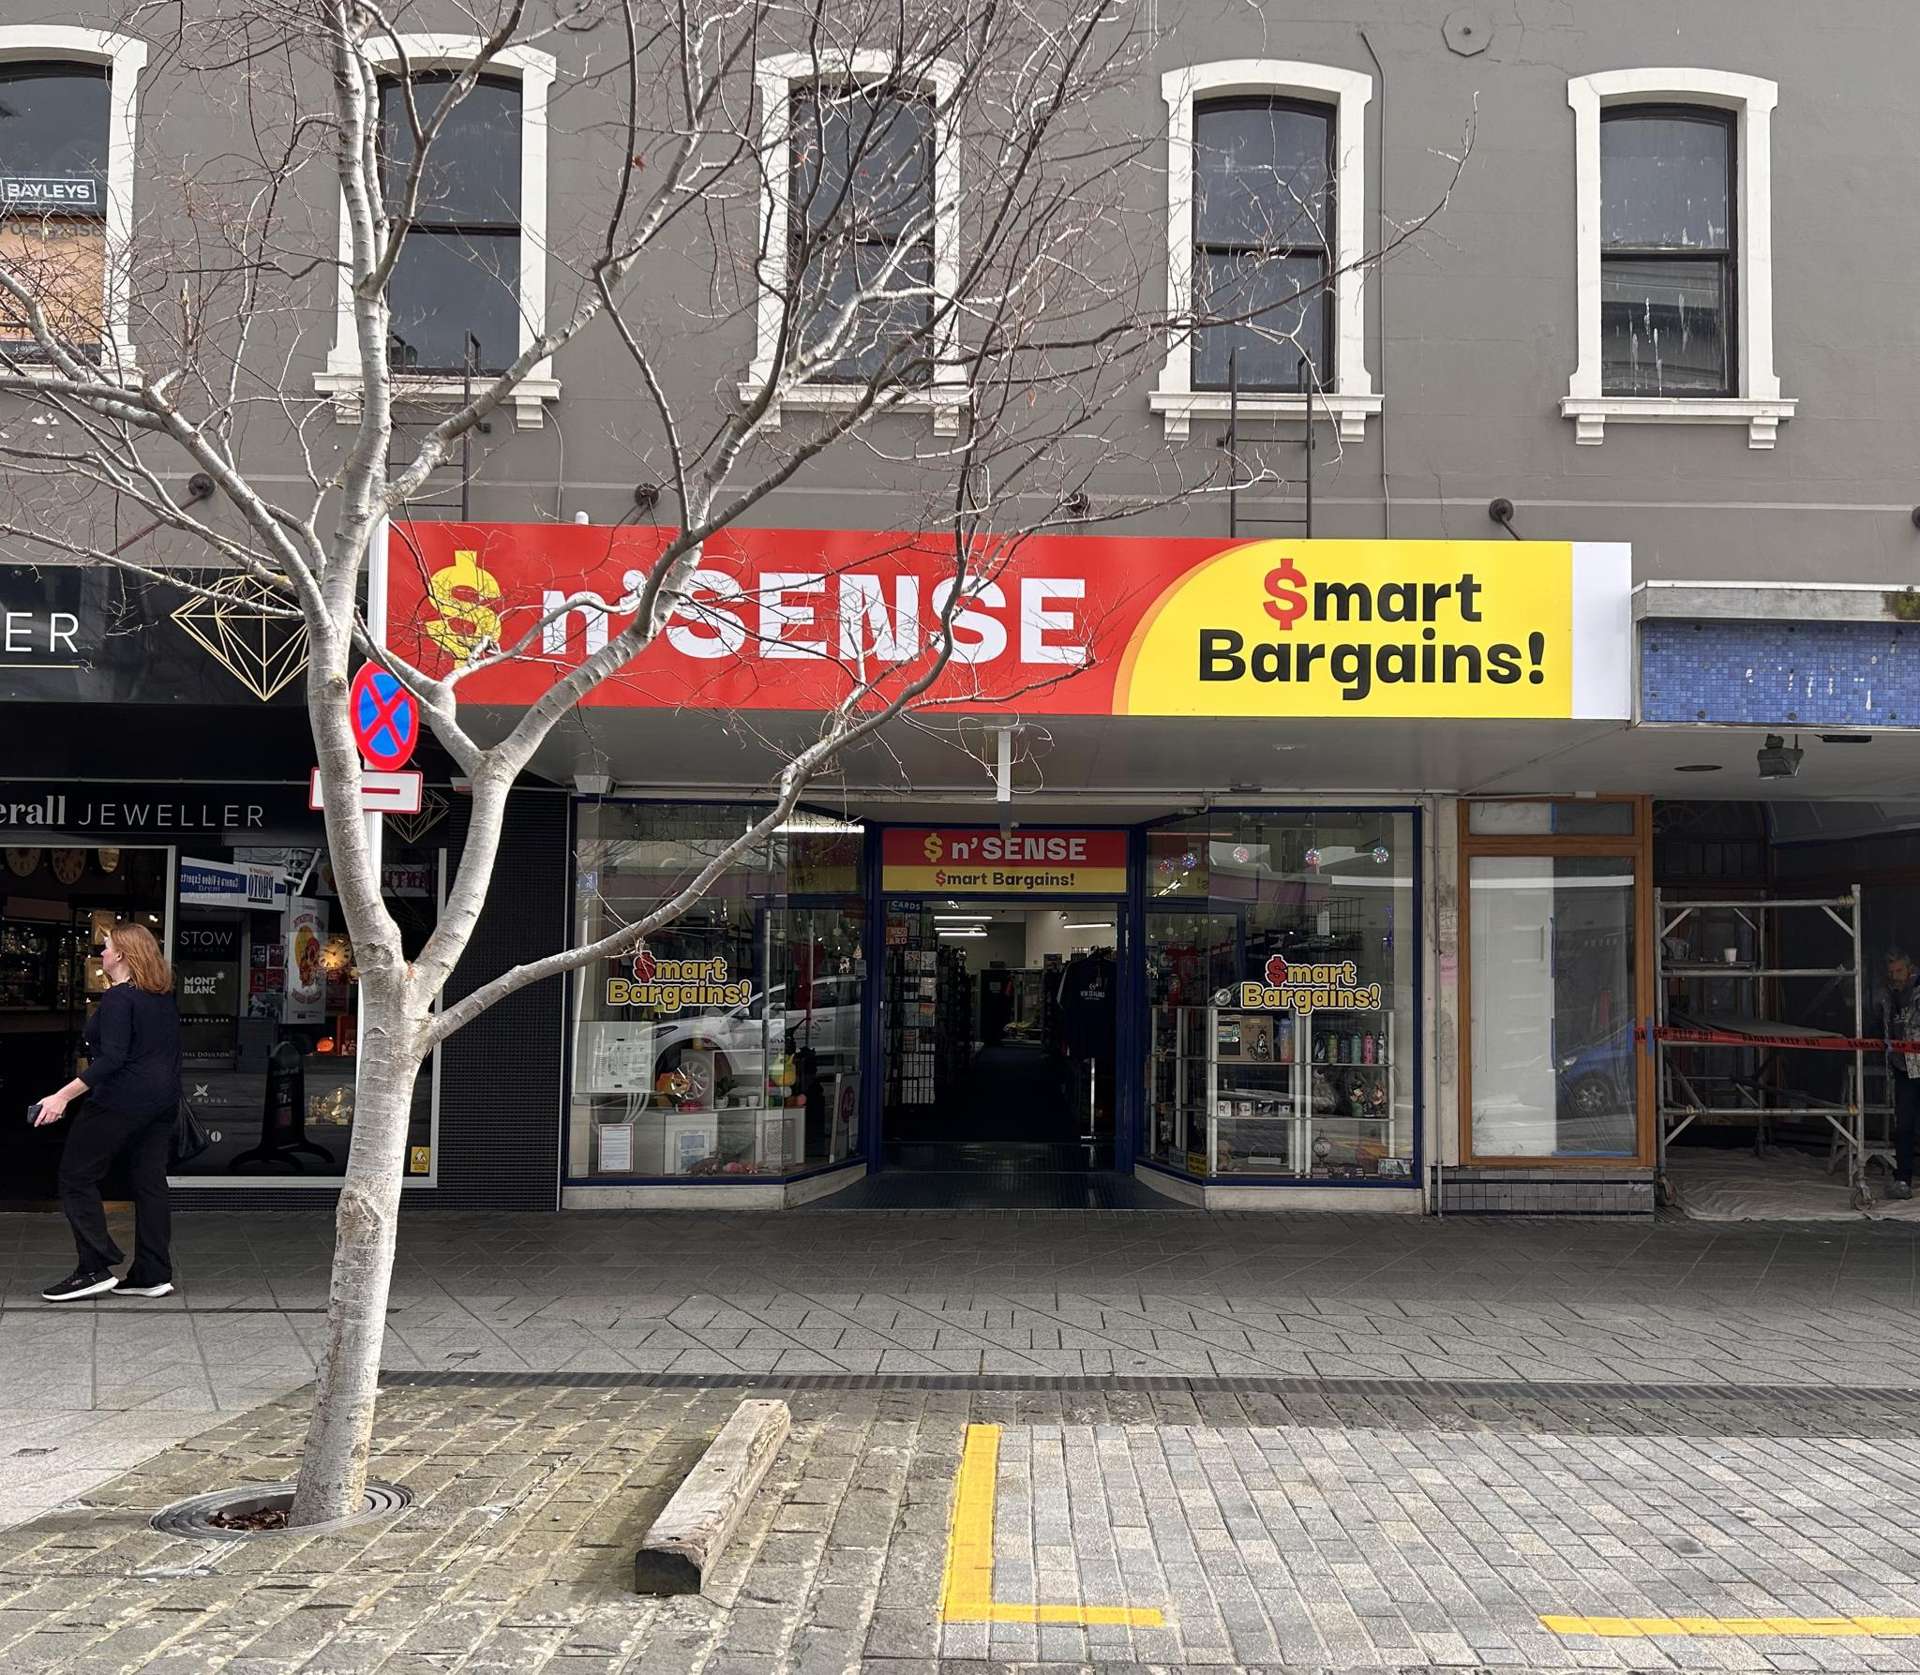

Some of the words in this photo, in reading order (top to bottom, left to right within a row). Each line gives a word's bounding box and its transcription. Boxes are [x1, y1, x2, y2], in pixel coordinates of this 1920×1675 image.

[7, 184, 90, 198] BAYLEYS
[423, 550, 502, 669] $
[1263, 558, 1482, 630] $mart
[5, 611, 79, 653] ER
[1199, 627, 1545, 700] Bargains!
[78, 803, 264, 827] JEWELLER
[923, 832, 943, 863] $
[951, 836, 1088, 861] n'SENSE
[936, 868, 988, 886] $mart
[993, 871, 1075, 889] Bargains!
[892, 901, 920, 910] CARDS
[180, 931, 233, 945] STOW
[184, 976, 216, 985] MONT
[632, 950, 727, 983] $mart
[1265, 954, 1357, 987] $mart
[184, 985, 216, 994] BLANC
[607, 979, 752, 1013] Bargains!
[1241, 982, 1381, 1016] Bargains!
